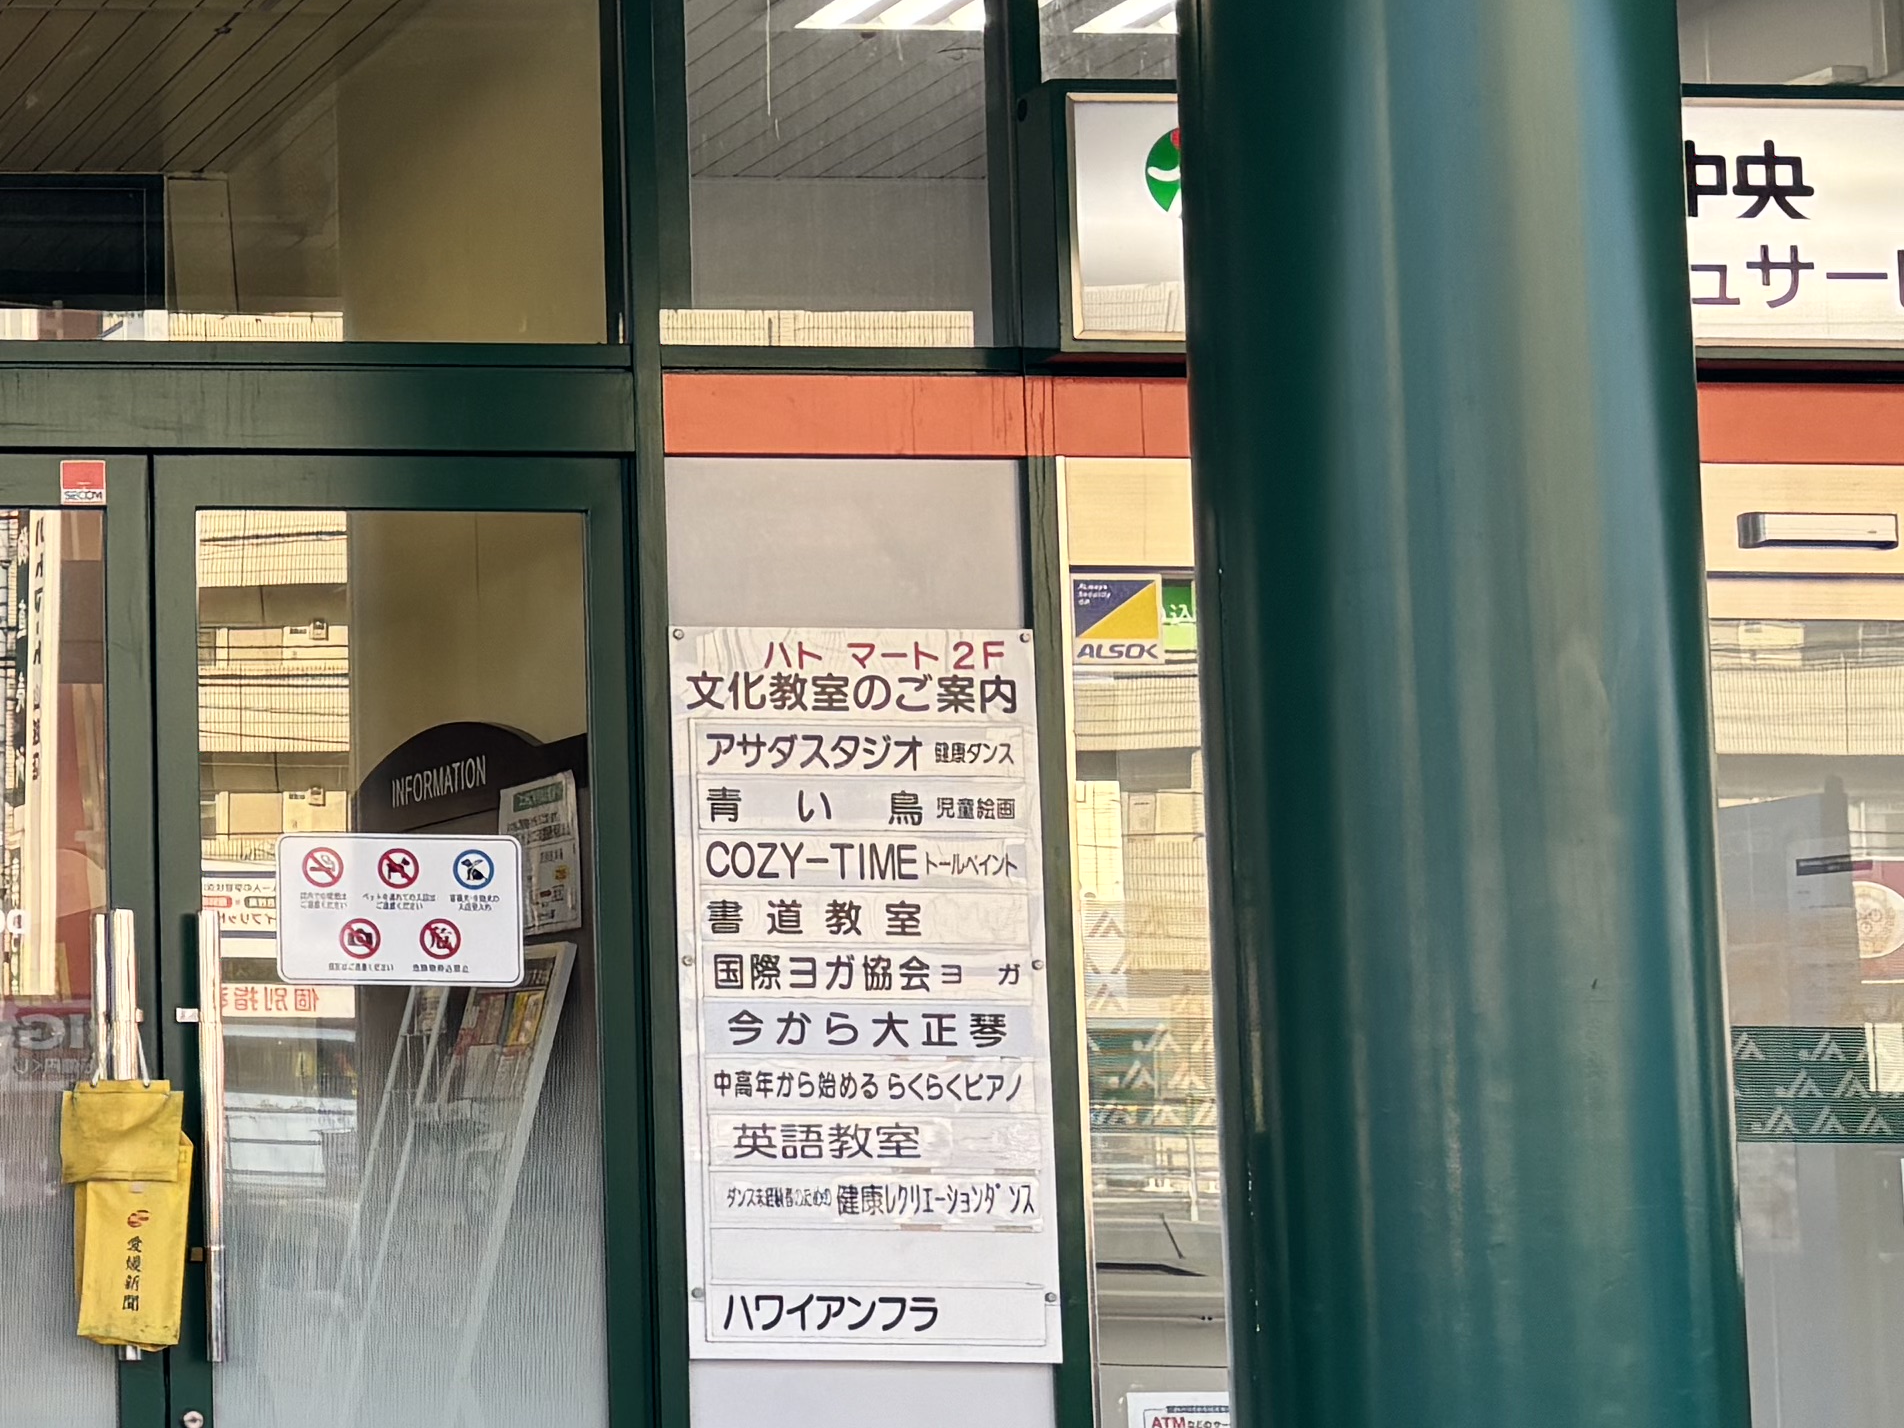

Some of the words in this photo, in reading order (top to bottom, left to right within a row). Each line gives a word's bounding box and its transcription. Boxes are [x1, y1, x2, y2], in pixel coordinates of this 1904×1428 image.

[1691, 243, 1904, 309] ュサー
[1077, 643, 1159, 659] ALSOK
[686, 672, 1017, 714] 文化教室のご案内
[706, 733, 923, 771] アサダスタジオ
[934, 742, 1015, 765] 健康ダンス
[392, 755, 487, 809] INFORMATION
[936, 797, 1016, 821] 児童絵画
[706, 841, 919, 880] COZY-TIME
[925, 852, 1018, 877] トールペイント
[707, 900, 922, 936] 書道教室
[714, 954, 930, 992] 国際ヨガ協会
[727, 1009, 1007, 1048] 今から大正琴
[714, 1070, 878, 1100] 中高年から始める
[887, 1073, 1022, 1102] らくらくピアノ
[733, 1123, 921, 1160] 英語教室
[122, 1236, 143, 1312] 愛媛新聞
[723, 1294, 939, 1332] ハワイアンフラ
